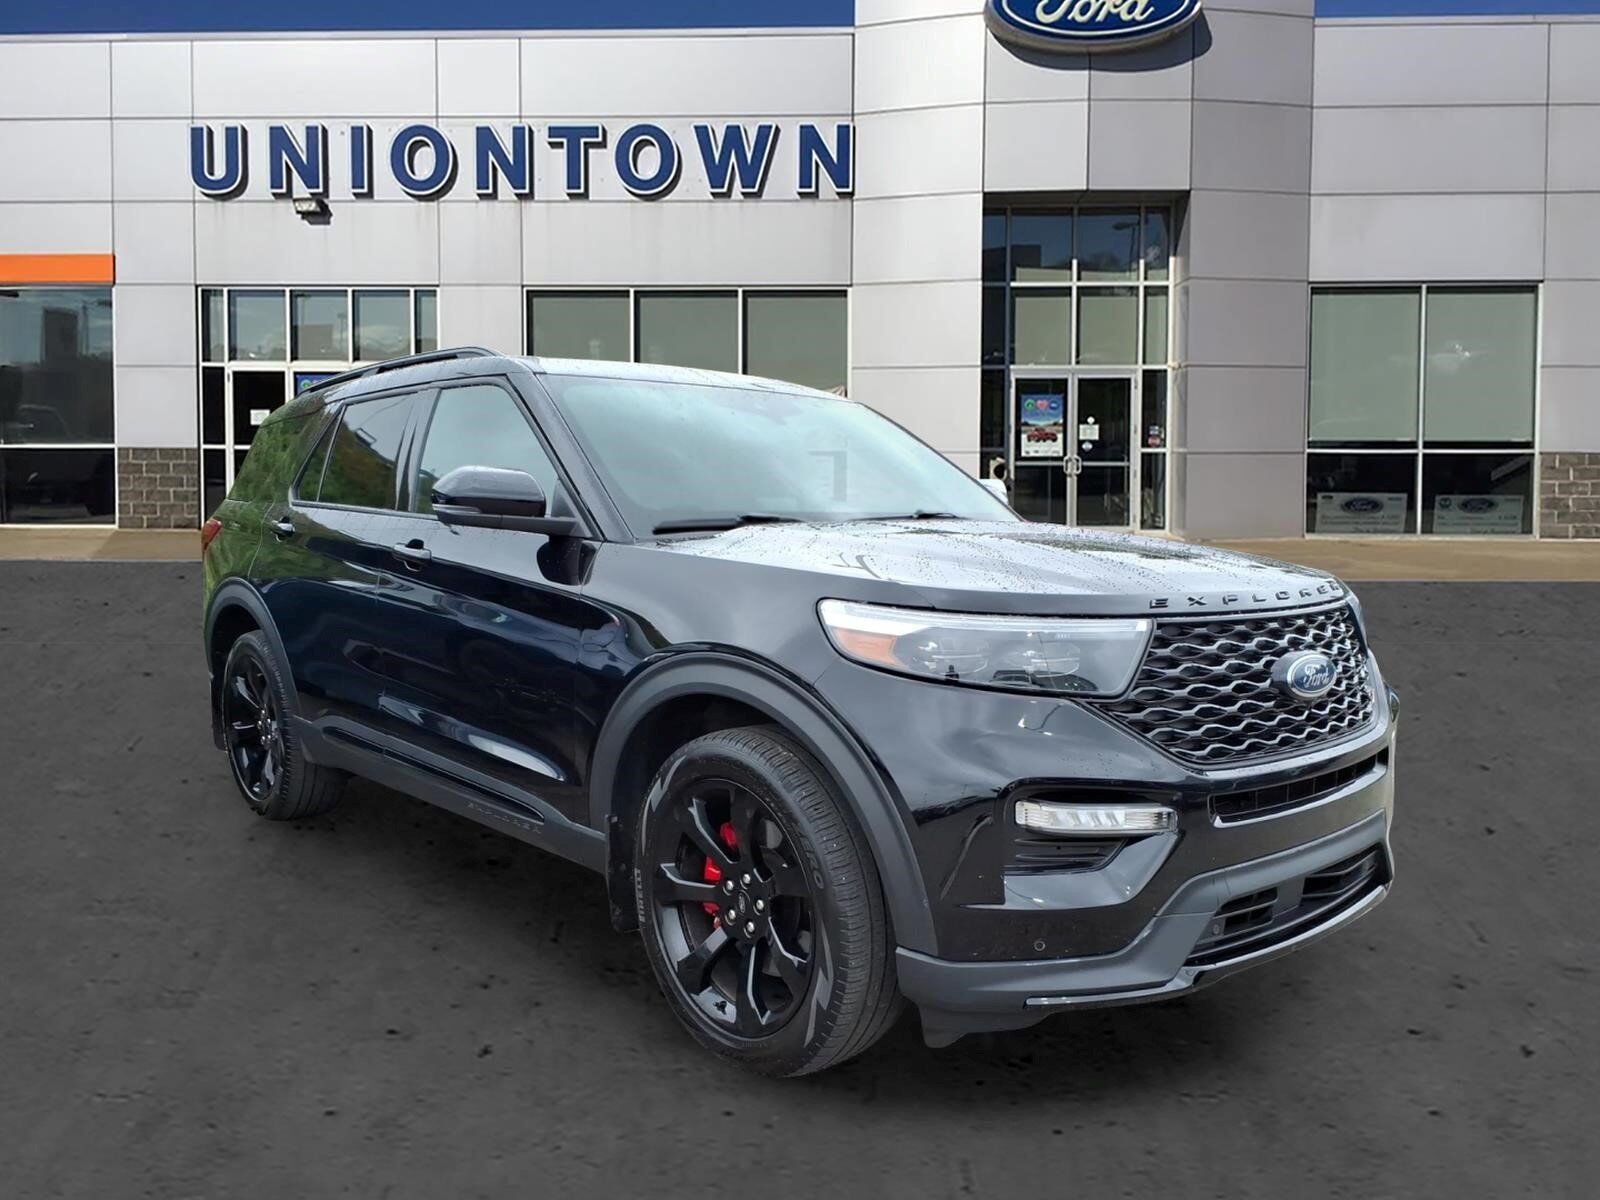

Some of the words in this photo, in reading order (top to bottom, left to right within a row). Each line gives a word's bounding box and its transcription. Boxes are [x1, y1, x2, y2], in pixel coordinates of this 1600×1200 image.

[190, 123, 853, 199] UNIONTOWN
[1150, 580, 1340, 608] EXPLORER
[1303, 664, 1331, 688] Ford
